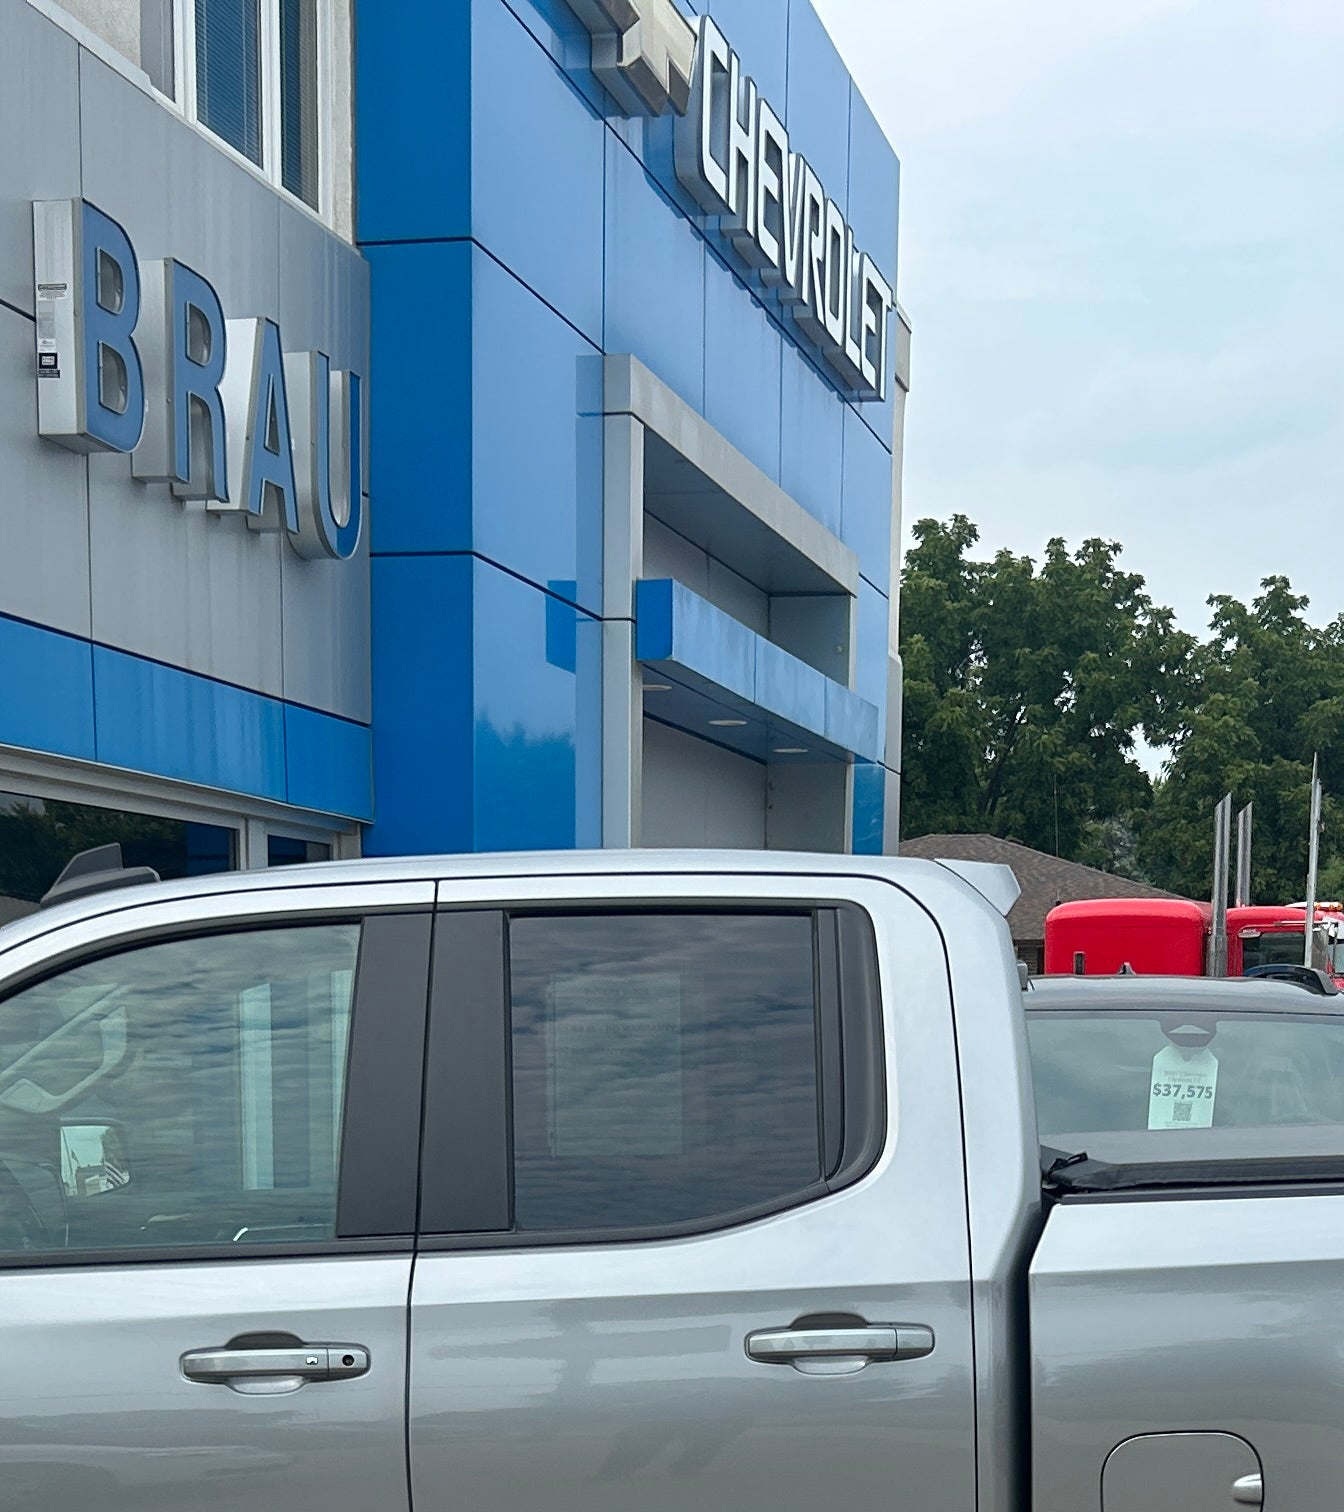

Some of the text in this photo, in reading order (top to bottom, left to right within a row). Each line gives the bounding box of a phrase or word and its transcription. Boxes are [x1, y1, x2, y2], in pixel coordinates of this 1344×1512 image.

[80, 196, 363, 561] BRAU
[701, 14, 894, 402] CHEVROLET
[1152, 1082, 1214, 1100] $37,575
